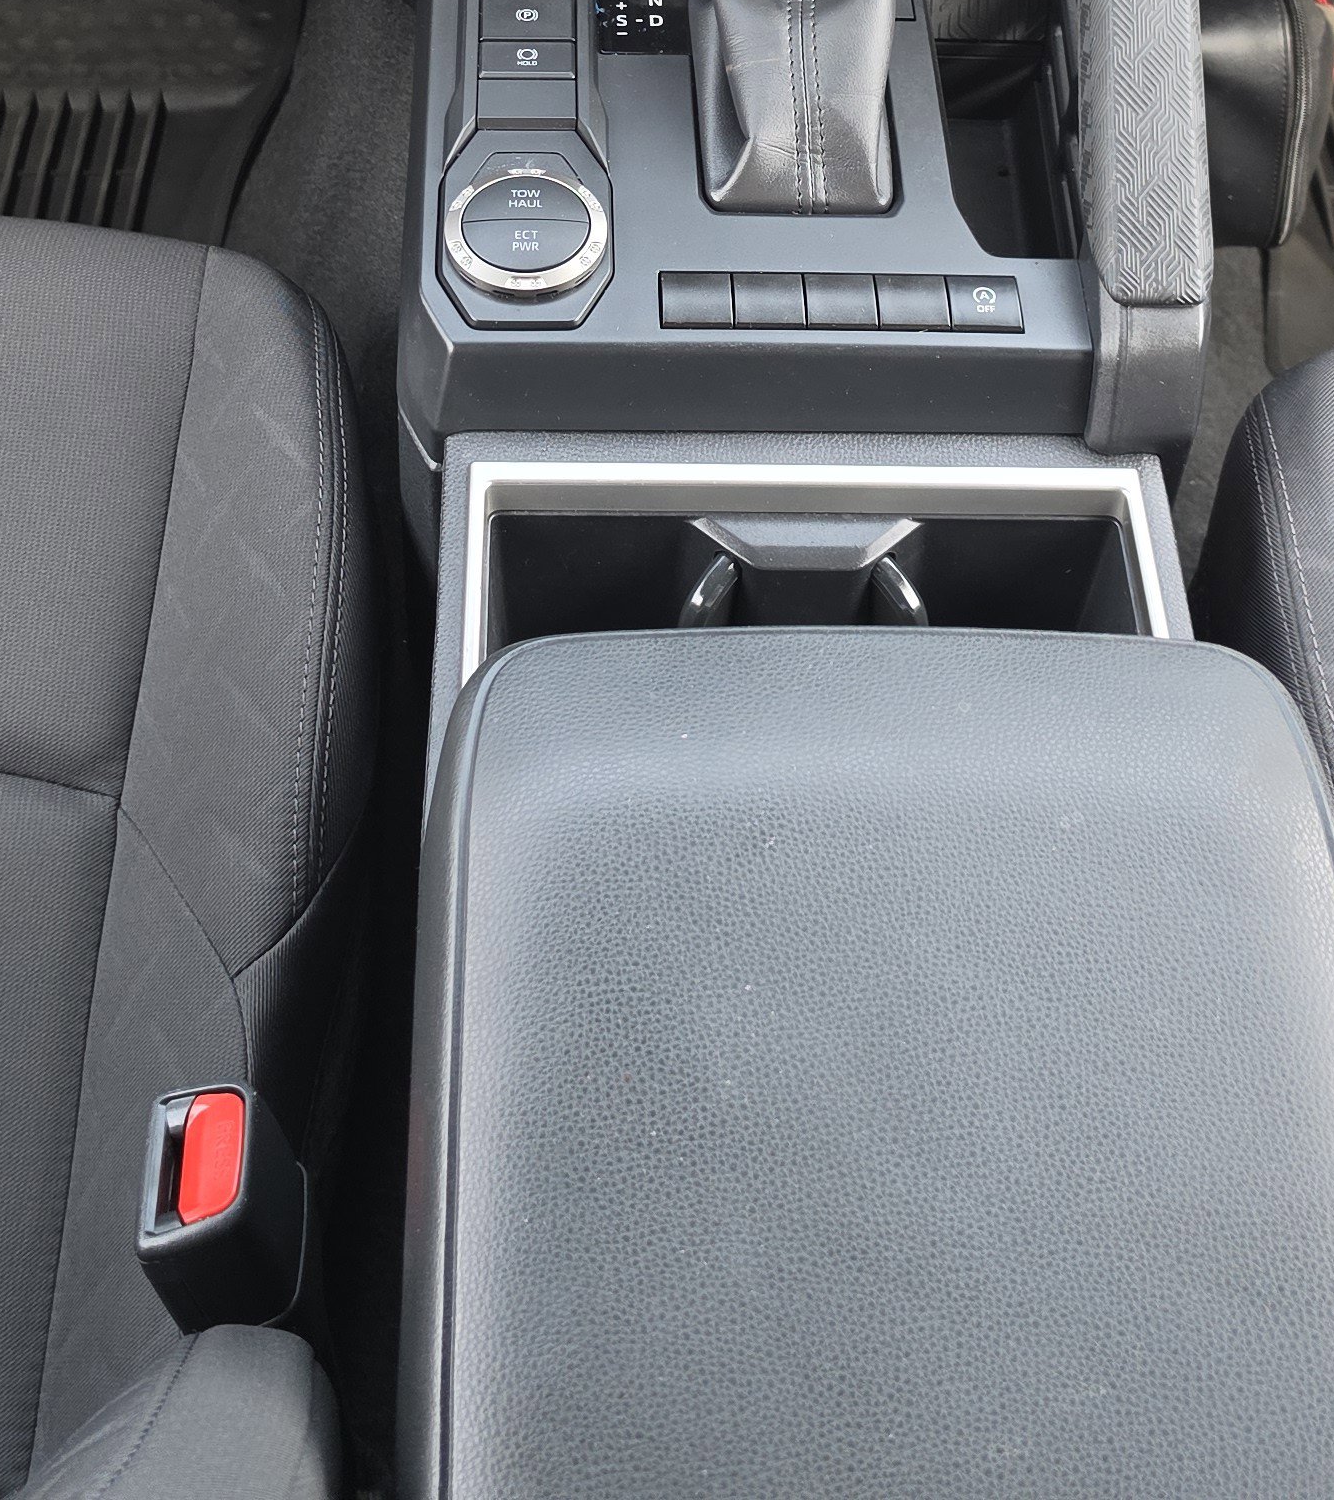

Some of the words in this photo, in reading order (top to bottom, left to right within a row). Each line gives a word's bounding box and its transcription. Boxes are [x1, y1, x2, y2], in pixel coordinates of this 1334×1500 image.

[616, 14, 628, 27] S
[649, 14, 664, 27] D
[510, 189, 541, 198] TOW
[508, 199, 543, 208] HAUL
[514, 230, 539, 240] ECT
[512, 242, 539, 251] PWR
[976, 304, 996, 313] OFF
